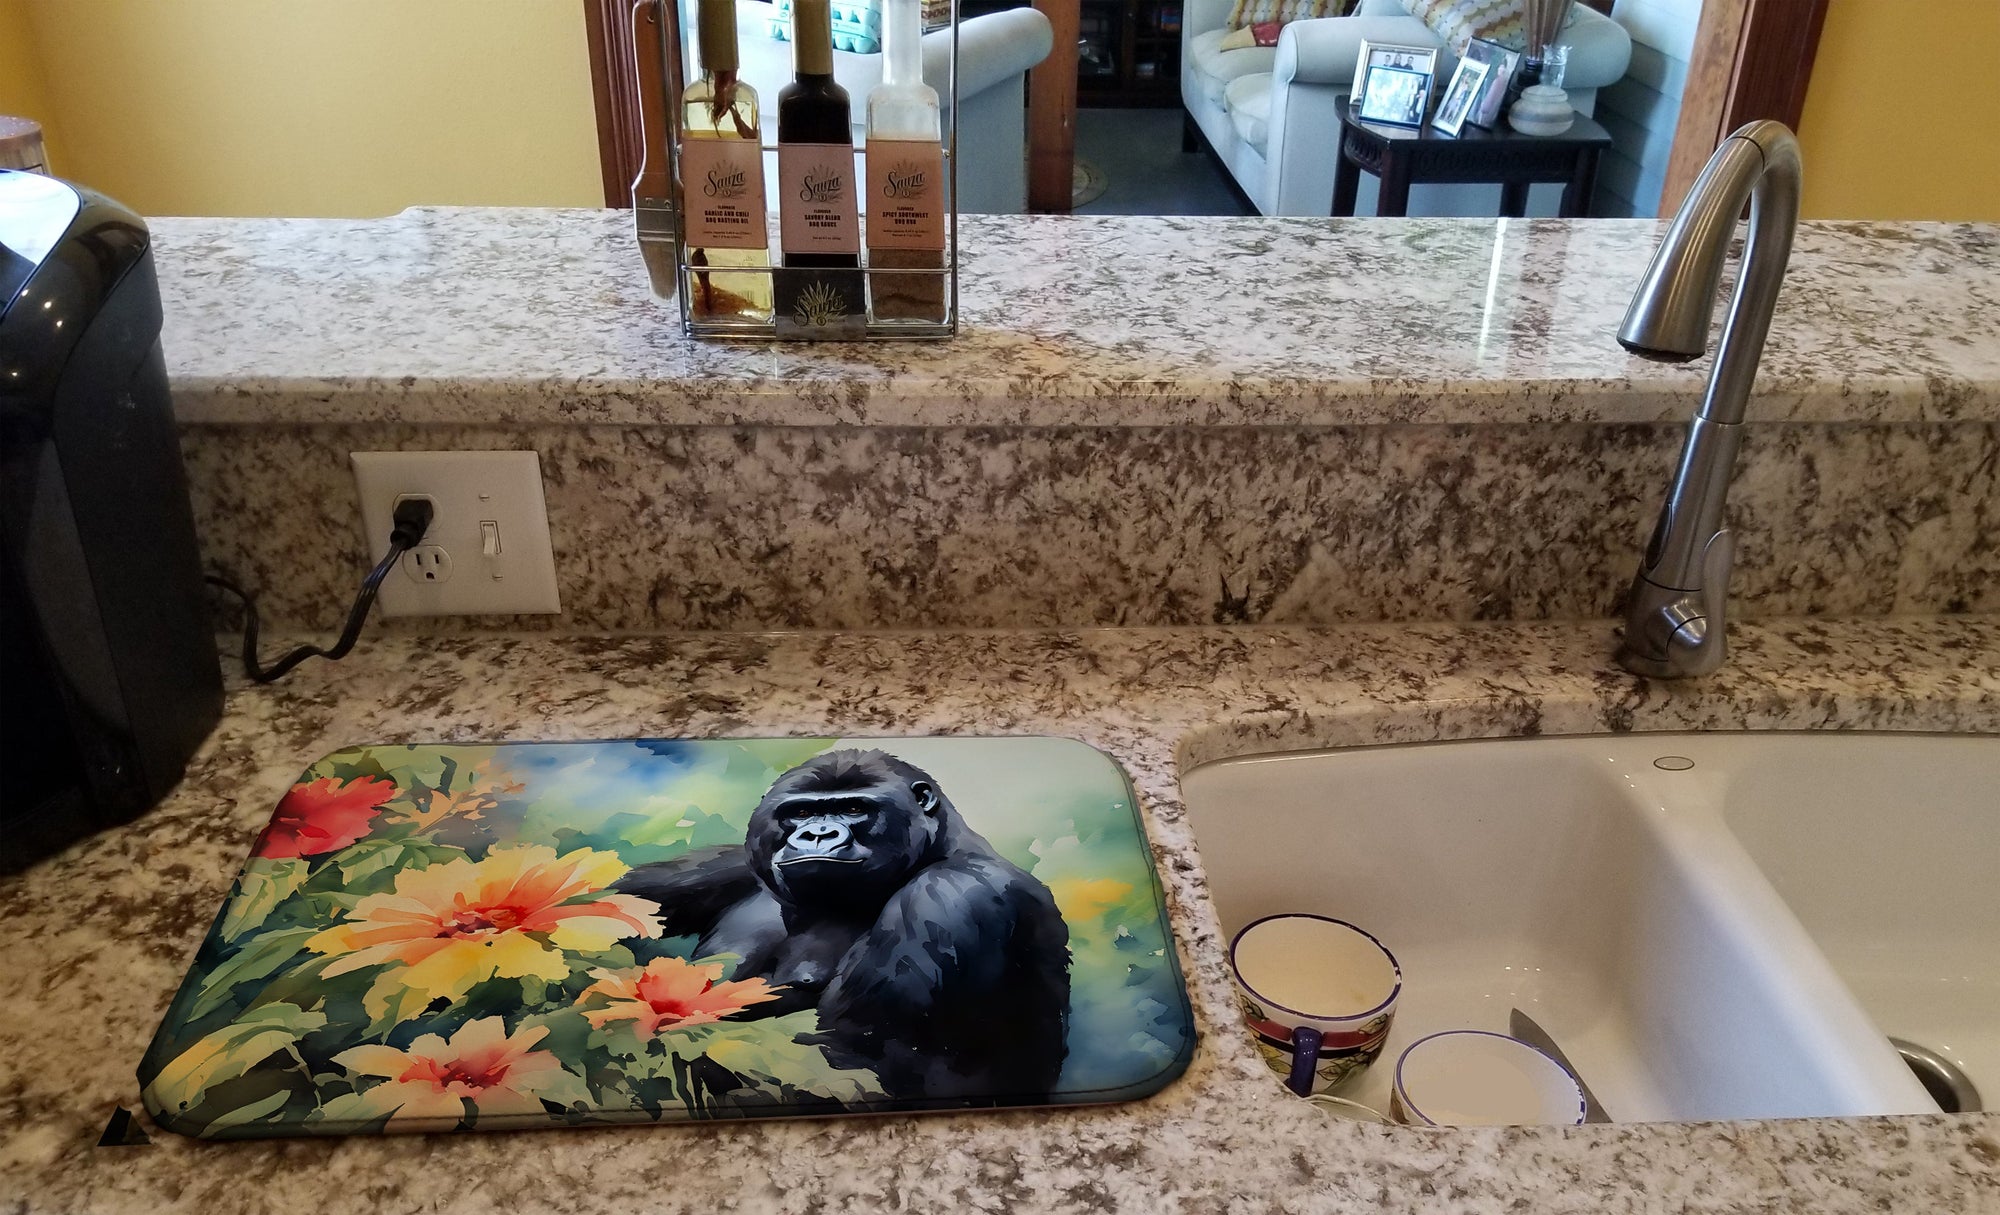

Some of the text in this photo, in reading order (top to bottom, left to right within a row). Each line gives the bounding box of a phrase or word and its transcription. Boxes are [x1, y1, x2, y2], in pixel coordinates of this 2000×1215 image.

[703, 170, 745, 197] Sauza
[800, 175, 841, 202] Sauza
[883, 171, 925, 198] Sauza
